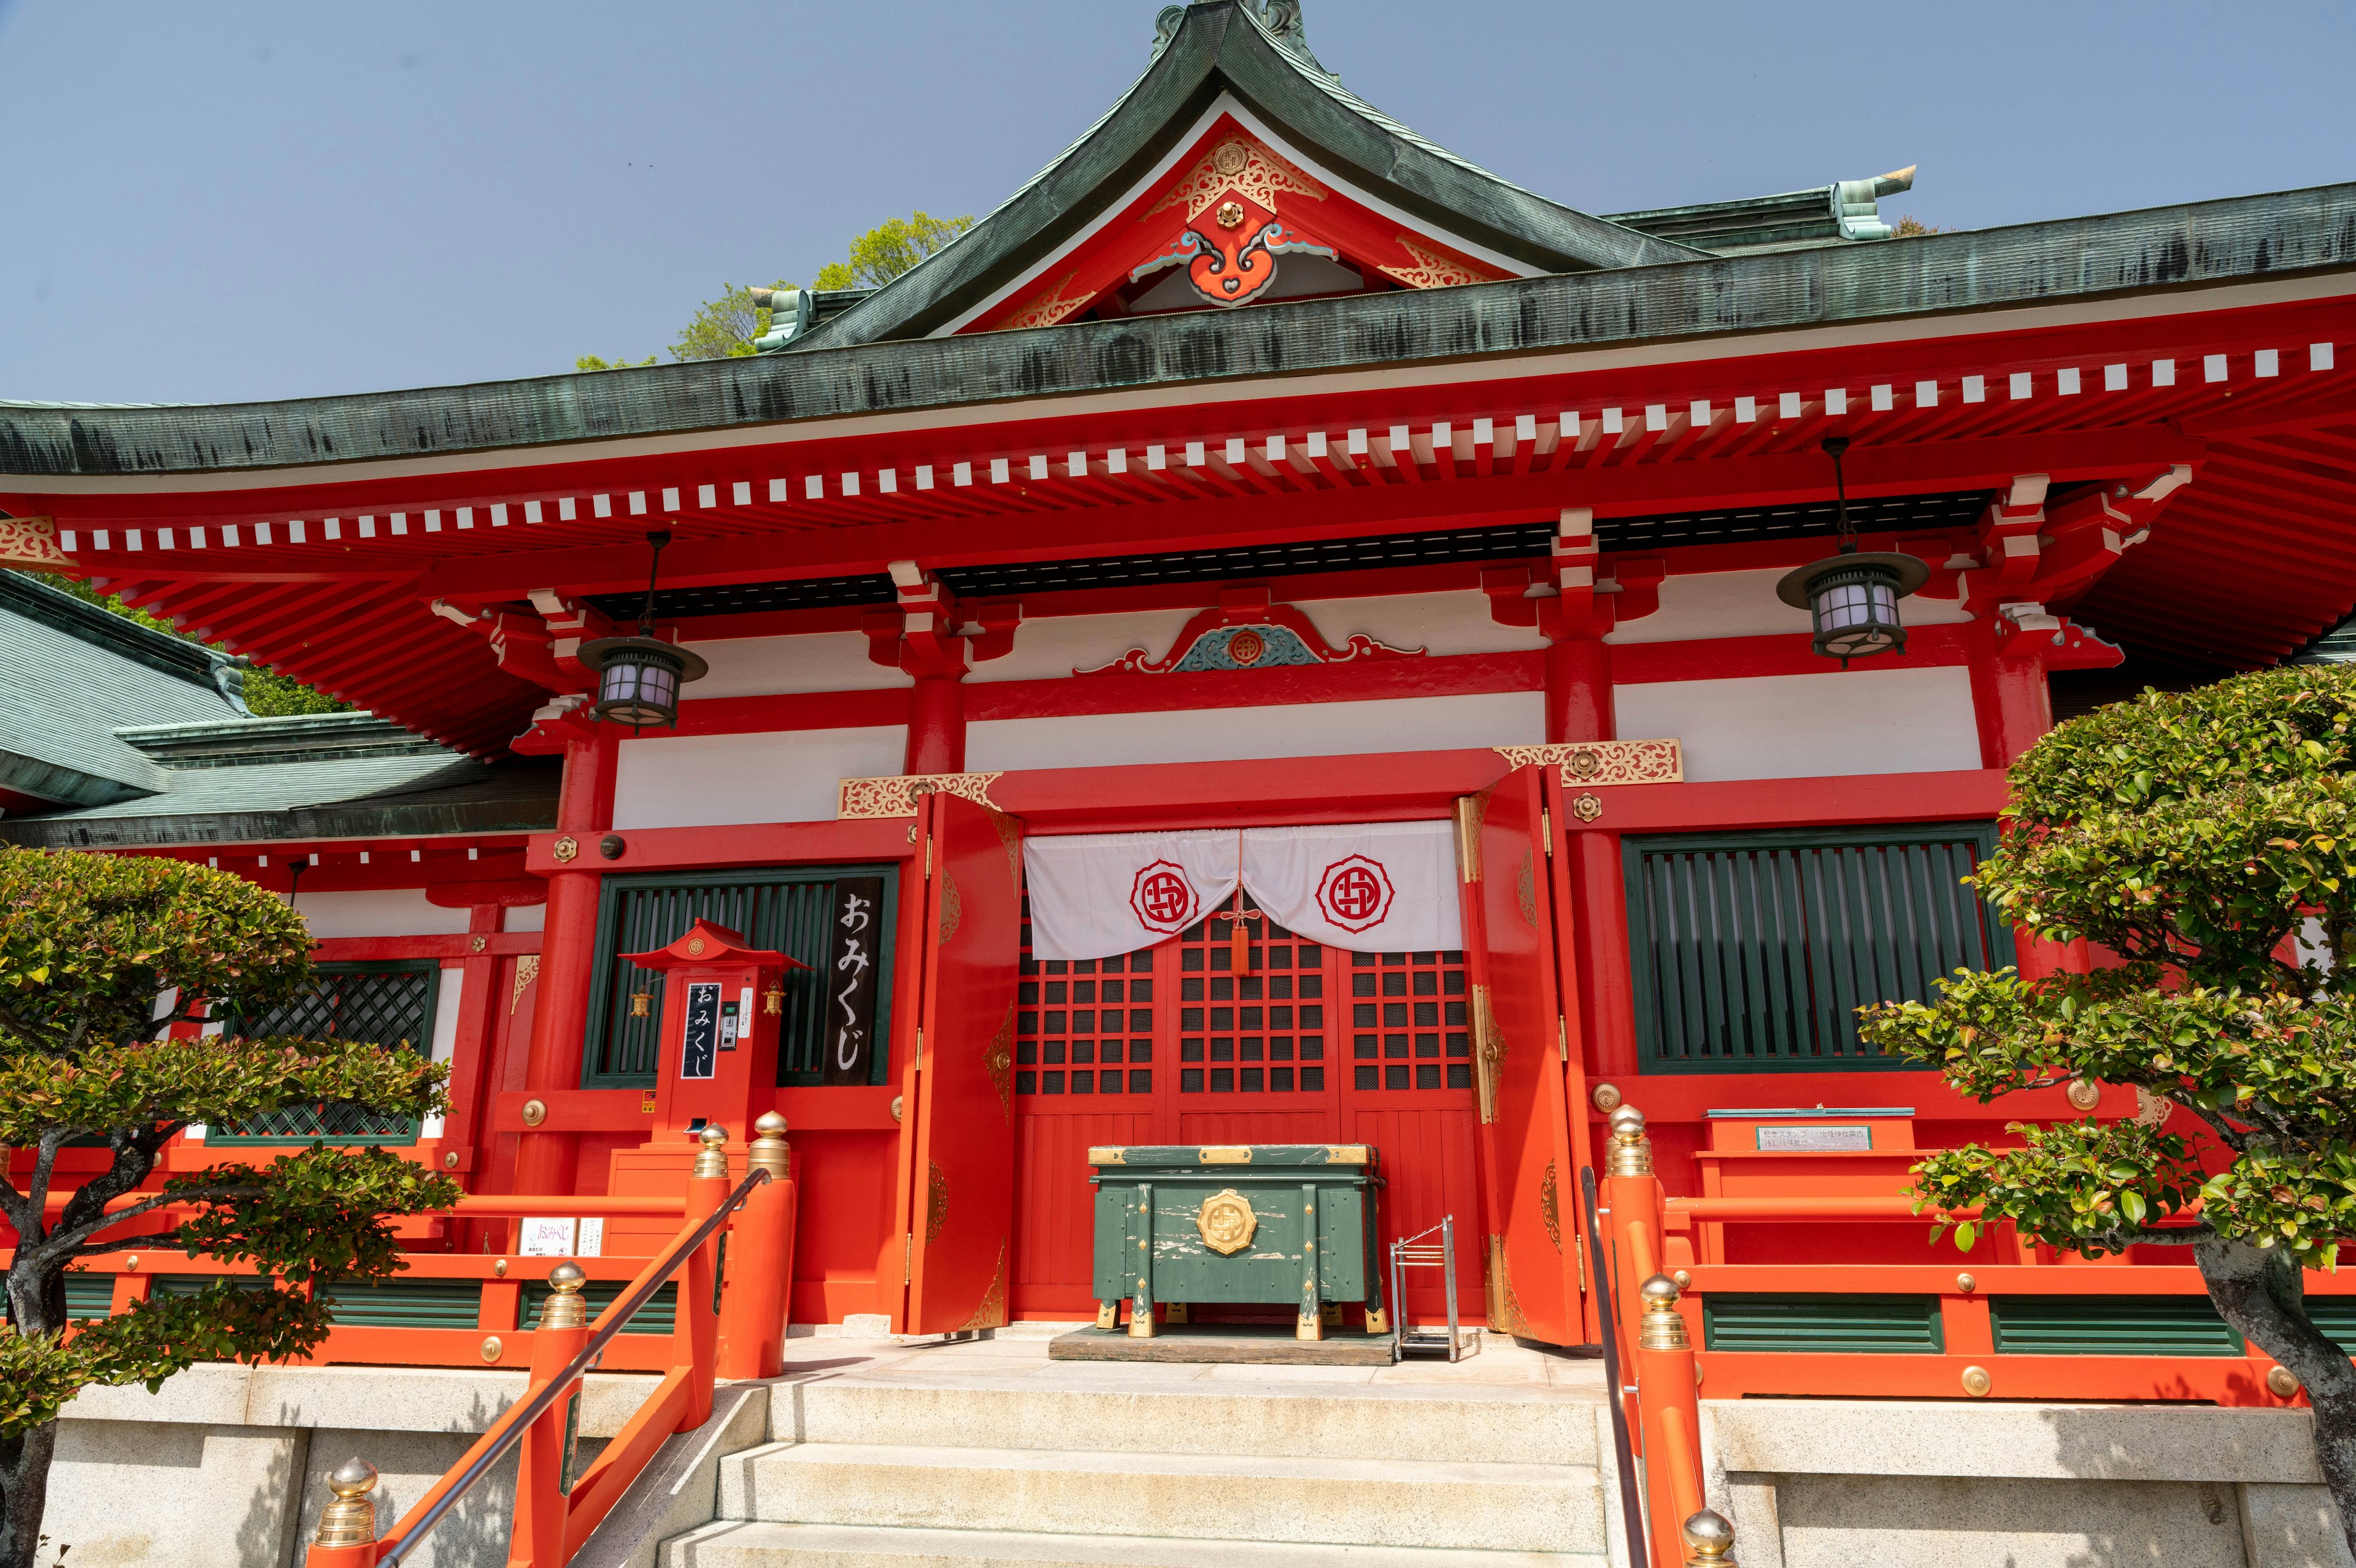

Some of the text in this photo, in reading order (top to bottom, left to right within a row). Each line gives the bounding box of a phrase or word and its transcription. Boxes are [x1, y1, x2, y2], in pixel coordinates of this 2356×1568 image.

[838, 894, 871, 1070] おみくじ
[695, 986, 713, 1077] おみくじ
[537, 1223, 569, 1240] おみくじ
